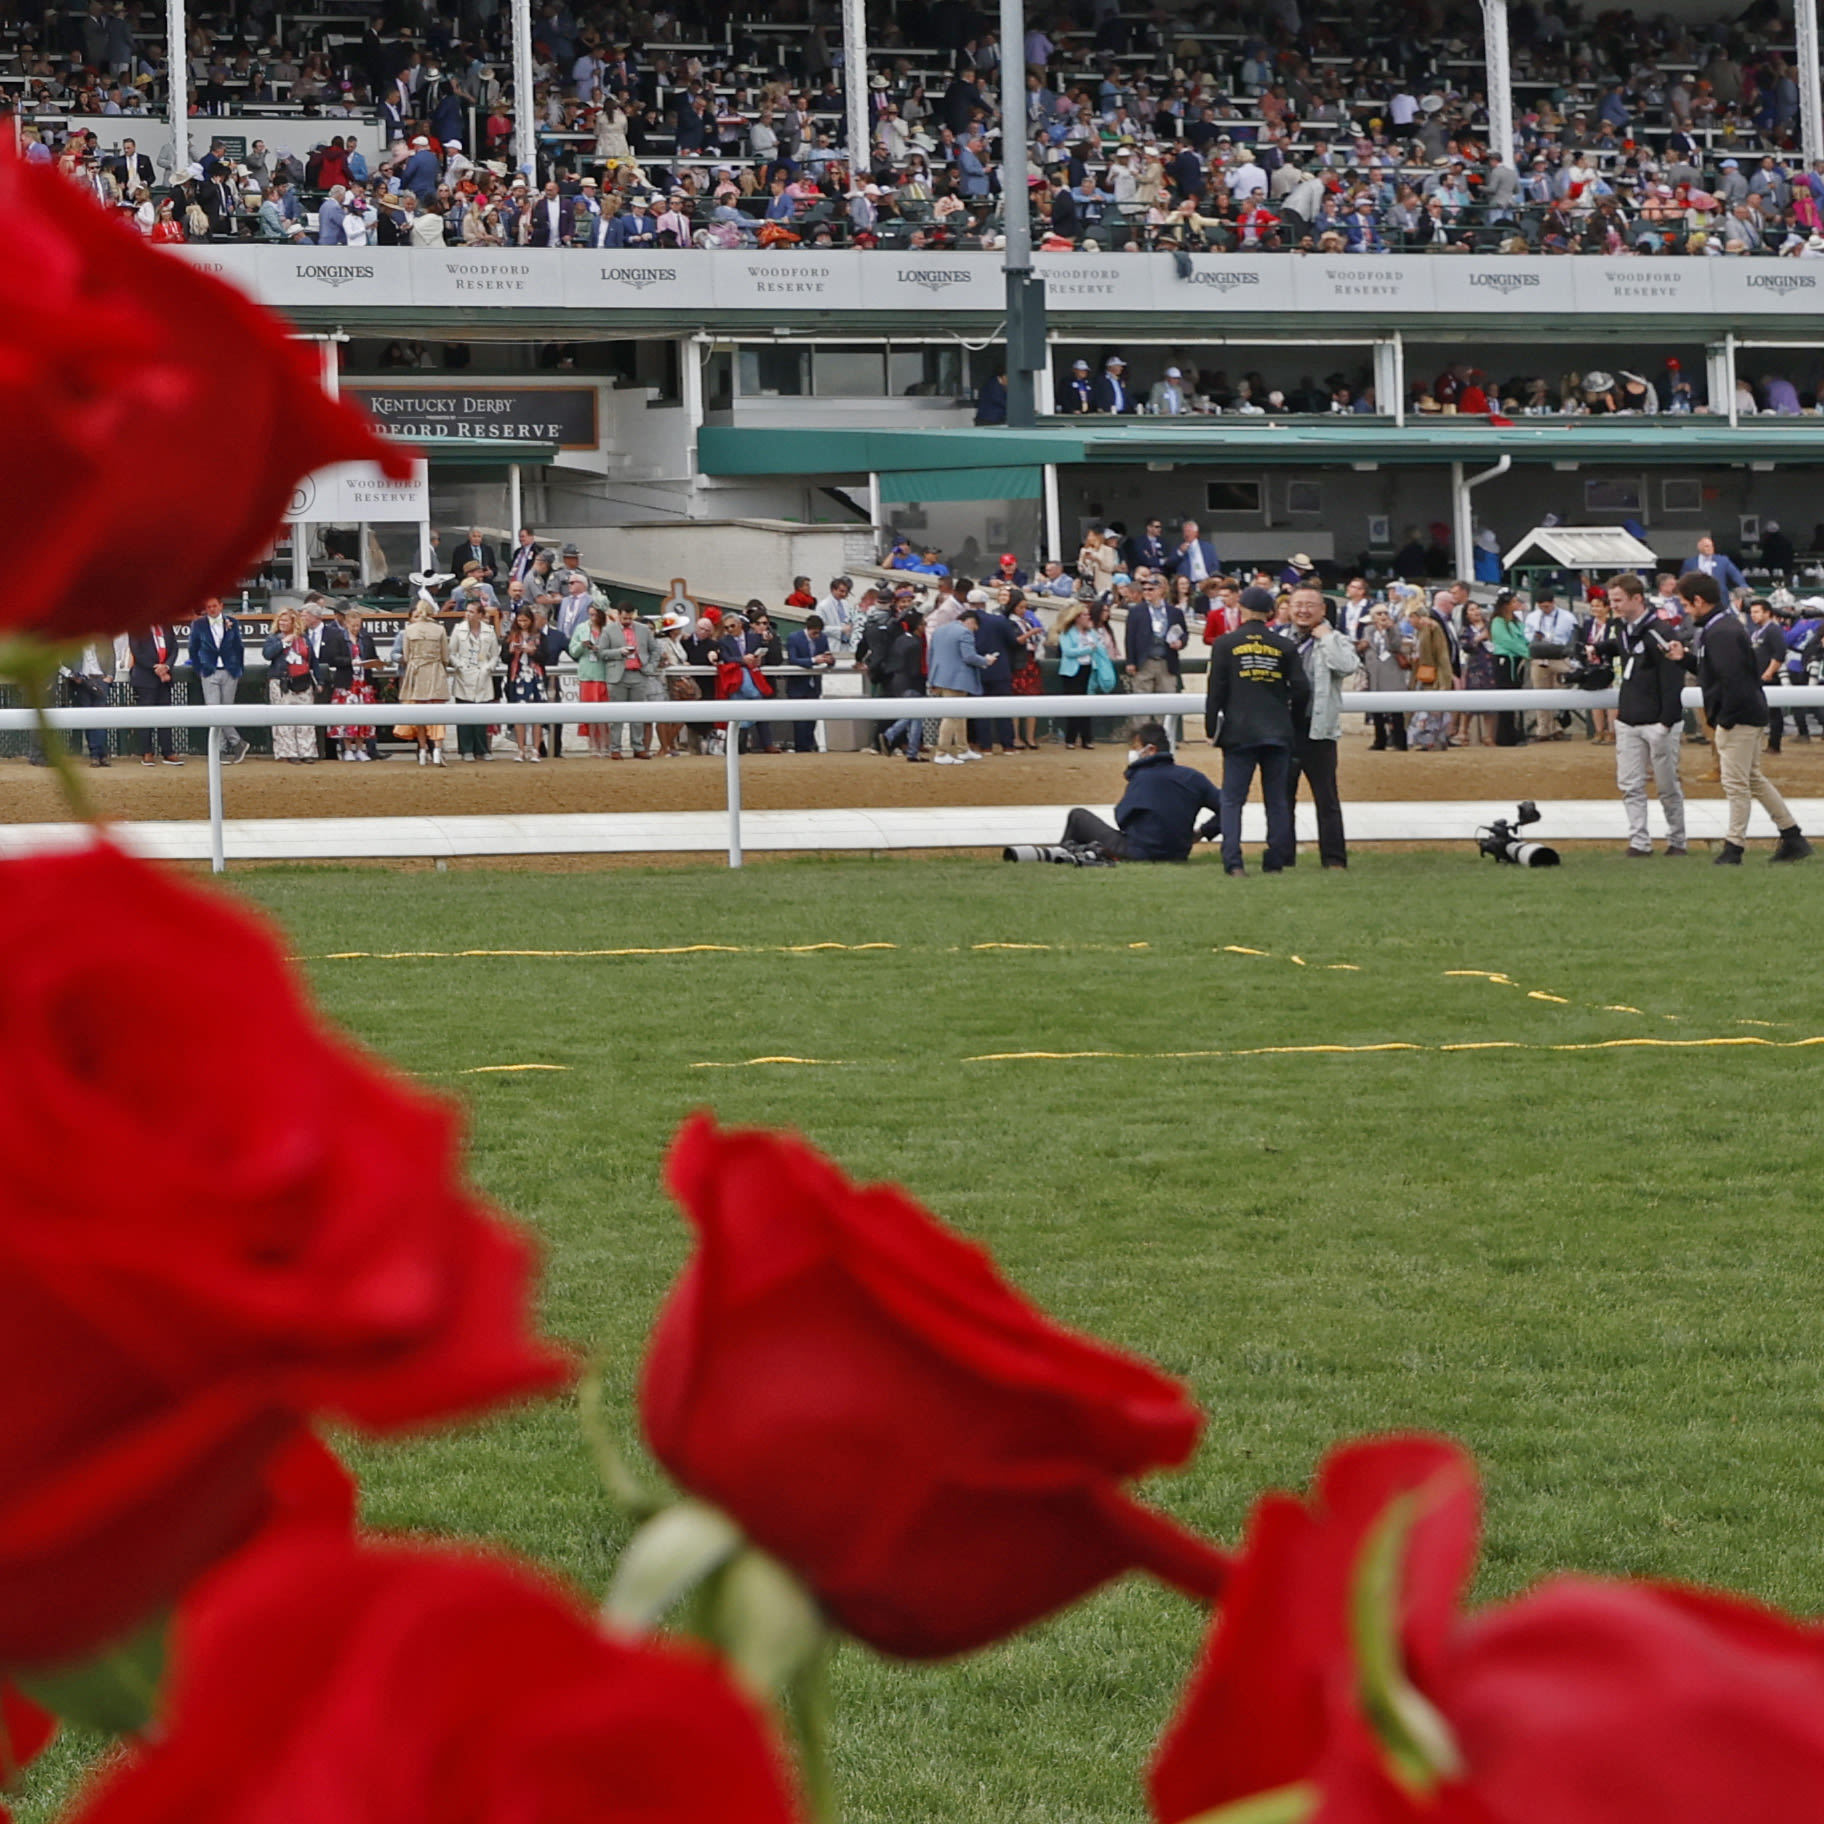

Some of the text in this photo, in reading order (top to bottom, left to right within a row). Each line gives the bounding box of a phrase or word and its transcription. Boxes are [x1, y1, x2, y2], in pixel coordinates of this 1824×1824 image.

[296, 265, 374, 278] LONGINES
[446, 264, 530, 275] WOODFORD
[600, 268, 677, 281] LONGINES
[747, 266, 830, 277] WOODFORD
[1039, 268, 1120, 279] WOODFORD
[897, 270, 971, 283] LONGINES
[1187, 272, 1260, 284] LONGINES
[1325, 270, 1404, 281] WOODFORD
[1469, 273, 1540, 286] LONGINES
[1605, 271, 1682, 282] WOODFORD
[1746, 275, 1817, 287] LONGINES
[455, 279, 525, 290] RESERVE
[756, 281, 825, 292] RESERVE
[1049, 283, 1115, 294] RESERVE
[1334, 285, 1399, 295] RESERVE
[1614, 286, 1677, 297] RESERVE
[371, 397, 513, 415] KENTUCKY DERBY
[457, 422, 560, 438] RESERVE
[346, 479, 422, 489] WOODFORD
[354, 493, 417, 502] RESERVE
